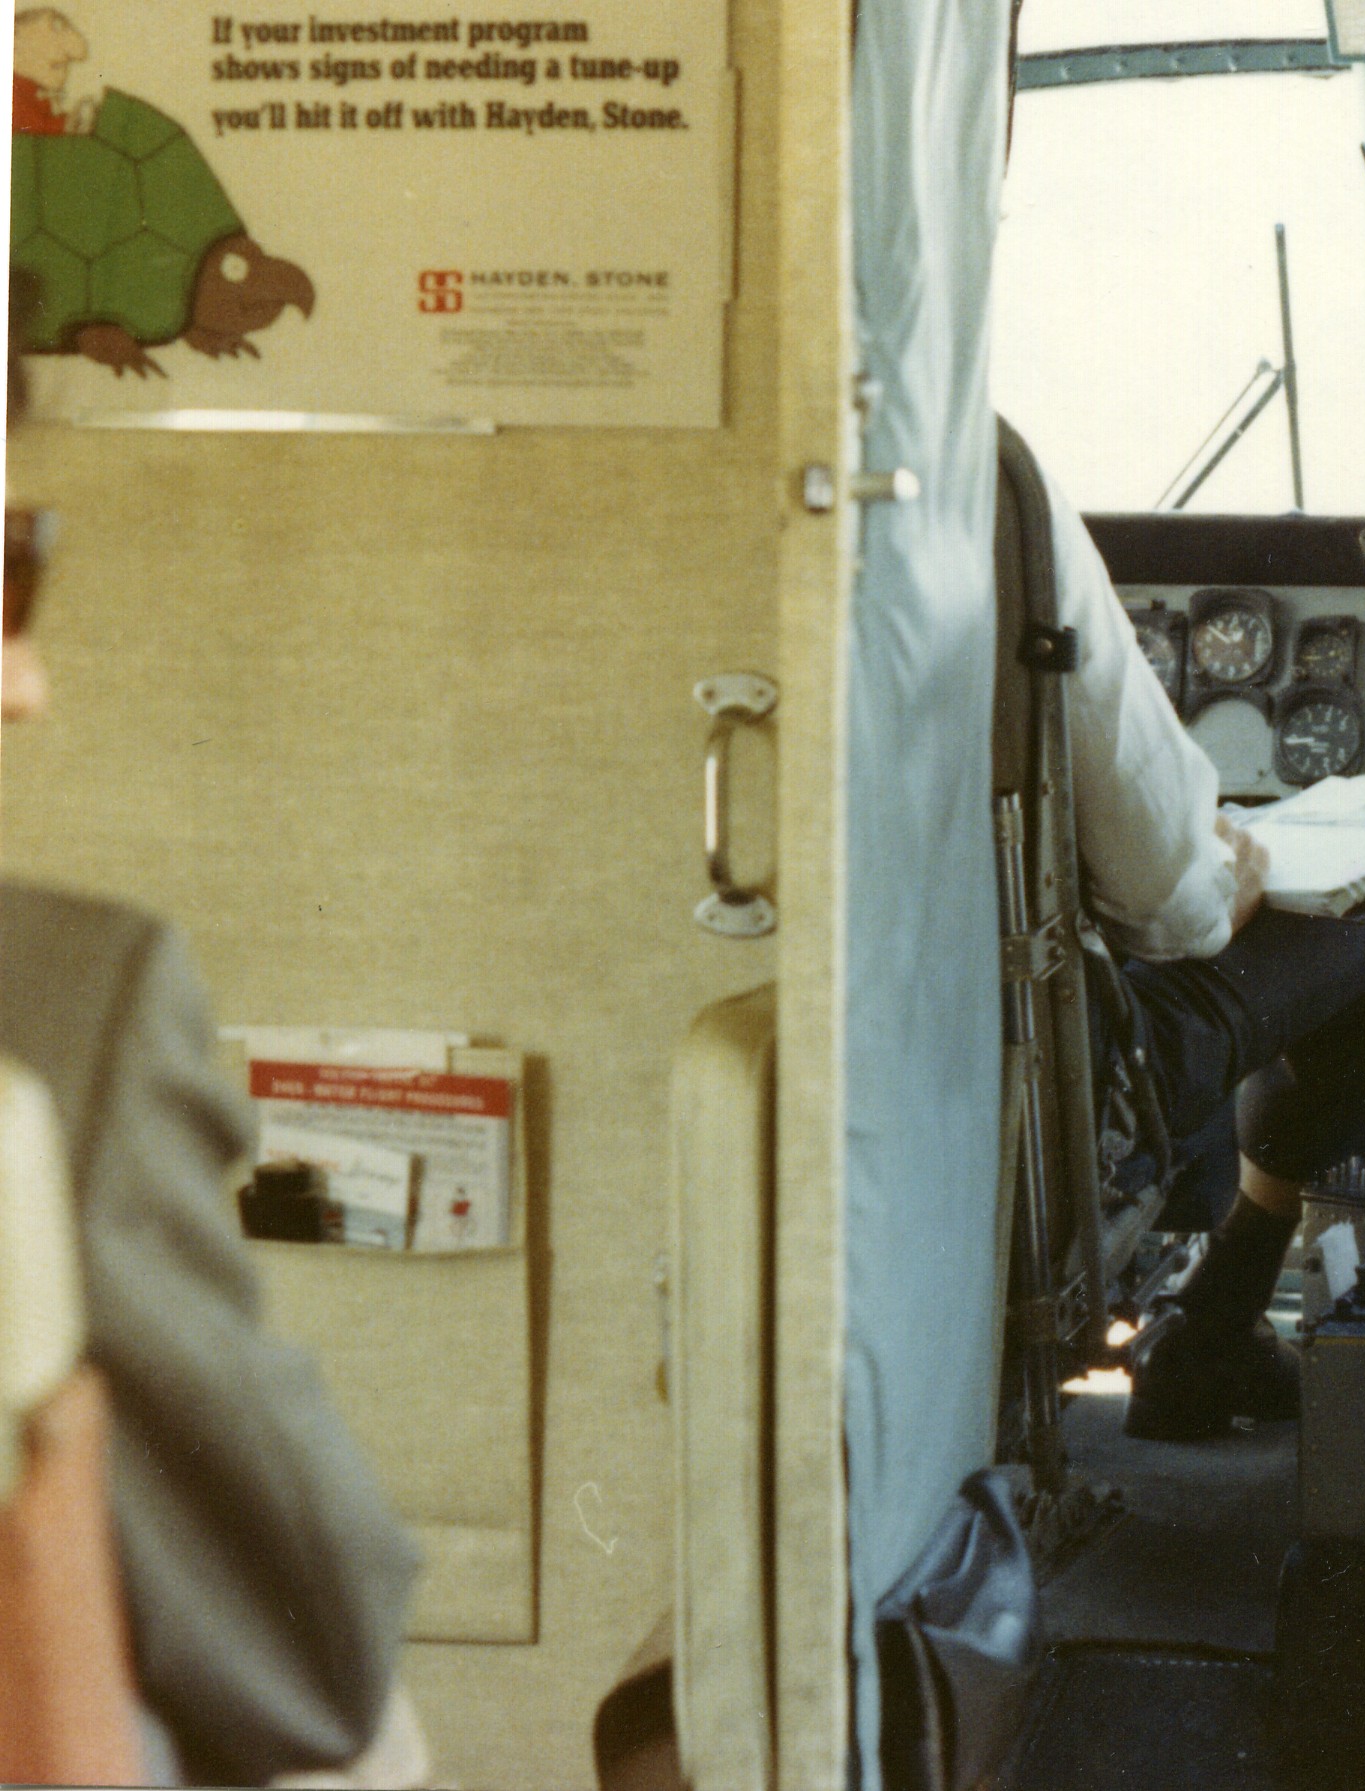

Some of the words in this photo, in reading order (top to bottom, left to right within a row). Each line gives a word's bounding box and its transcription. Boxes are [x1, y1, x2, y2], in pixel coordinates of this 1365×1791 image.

[212, 16, 232, 43] If
[240, 22, 301, 50] your
[308, 14, 459, 43] investment
[468, 20, 588, 49] program
[211, 52, 300, 80] shows
[309, 52, 381, 86] signs
[389, 51, 416, 80] of
[425, 51, 536, 86] needing
[545, 58, 560, 80] a
[569, 53, 680, 87] tune-up
[211, 101, 285, 138] you'll
[295, 100, 331, 130] hit
[340, 101, 357, 130] it
[365, 100, 403, 130] off
[411, 100, 476, 130] with
[486, 100, 597, 136] Hayden,
[602, 101, 689, 130] Stone.
[585, 271, 669, 287] STONE
